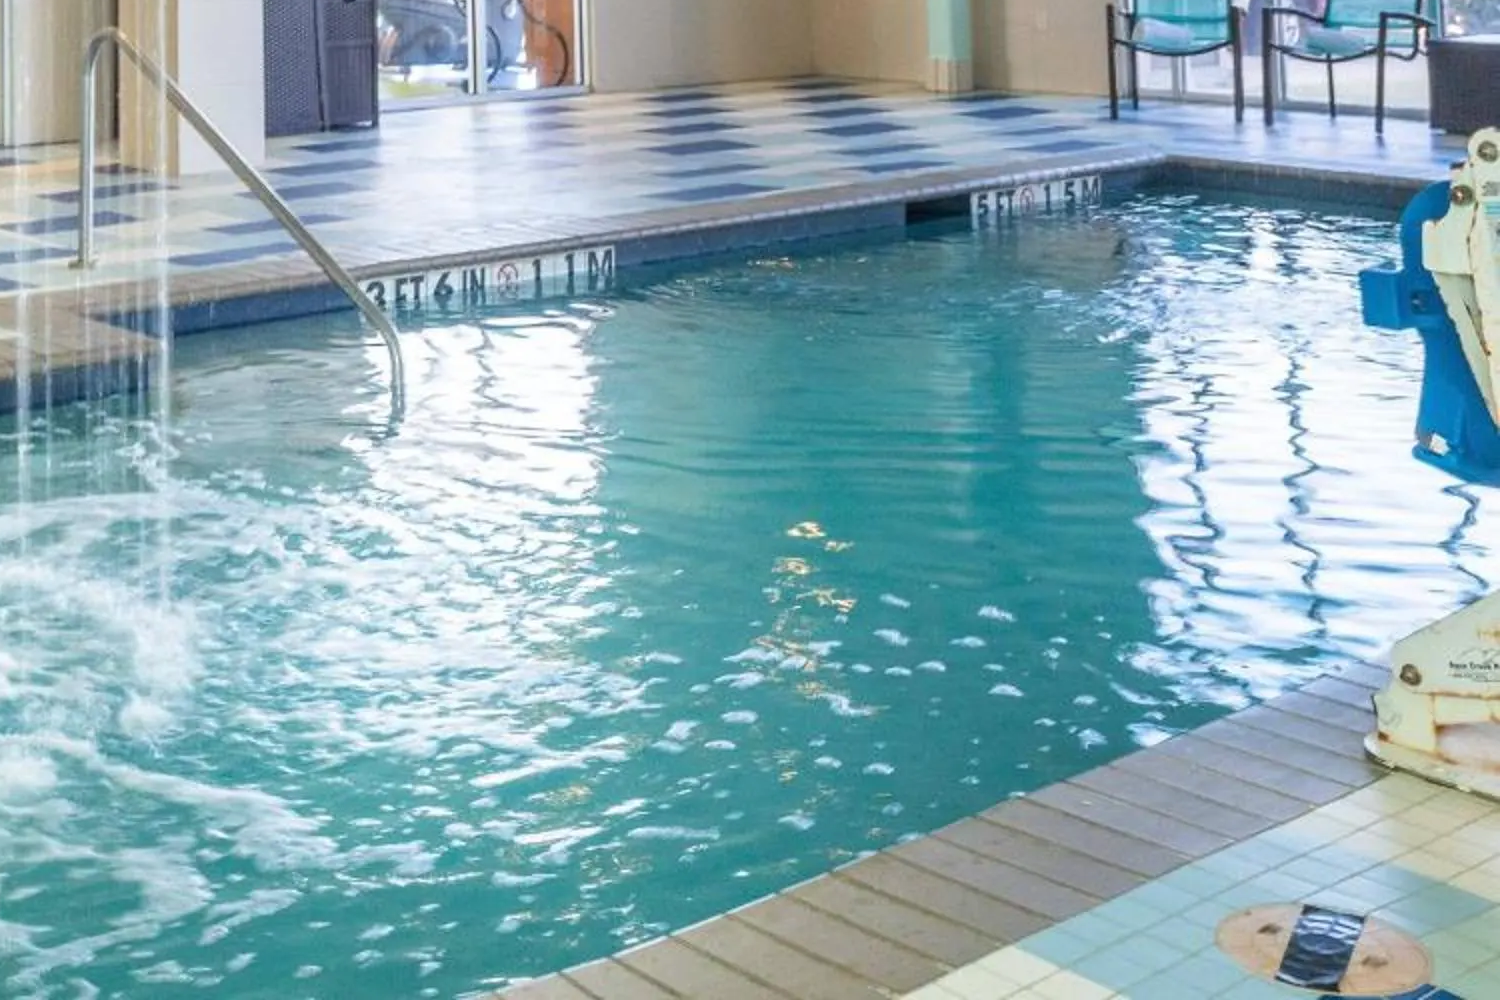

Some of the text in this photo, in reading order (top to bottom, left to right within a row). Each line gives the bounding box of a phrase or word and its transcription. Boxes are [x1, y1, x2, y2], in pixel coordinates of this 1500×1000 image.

[395, 275, 425, 302] FT
[434, 271, 453, 296] 6
[462, 266, 486, 292] IN
